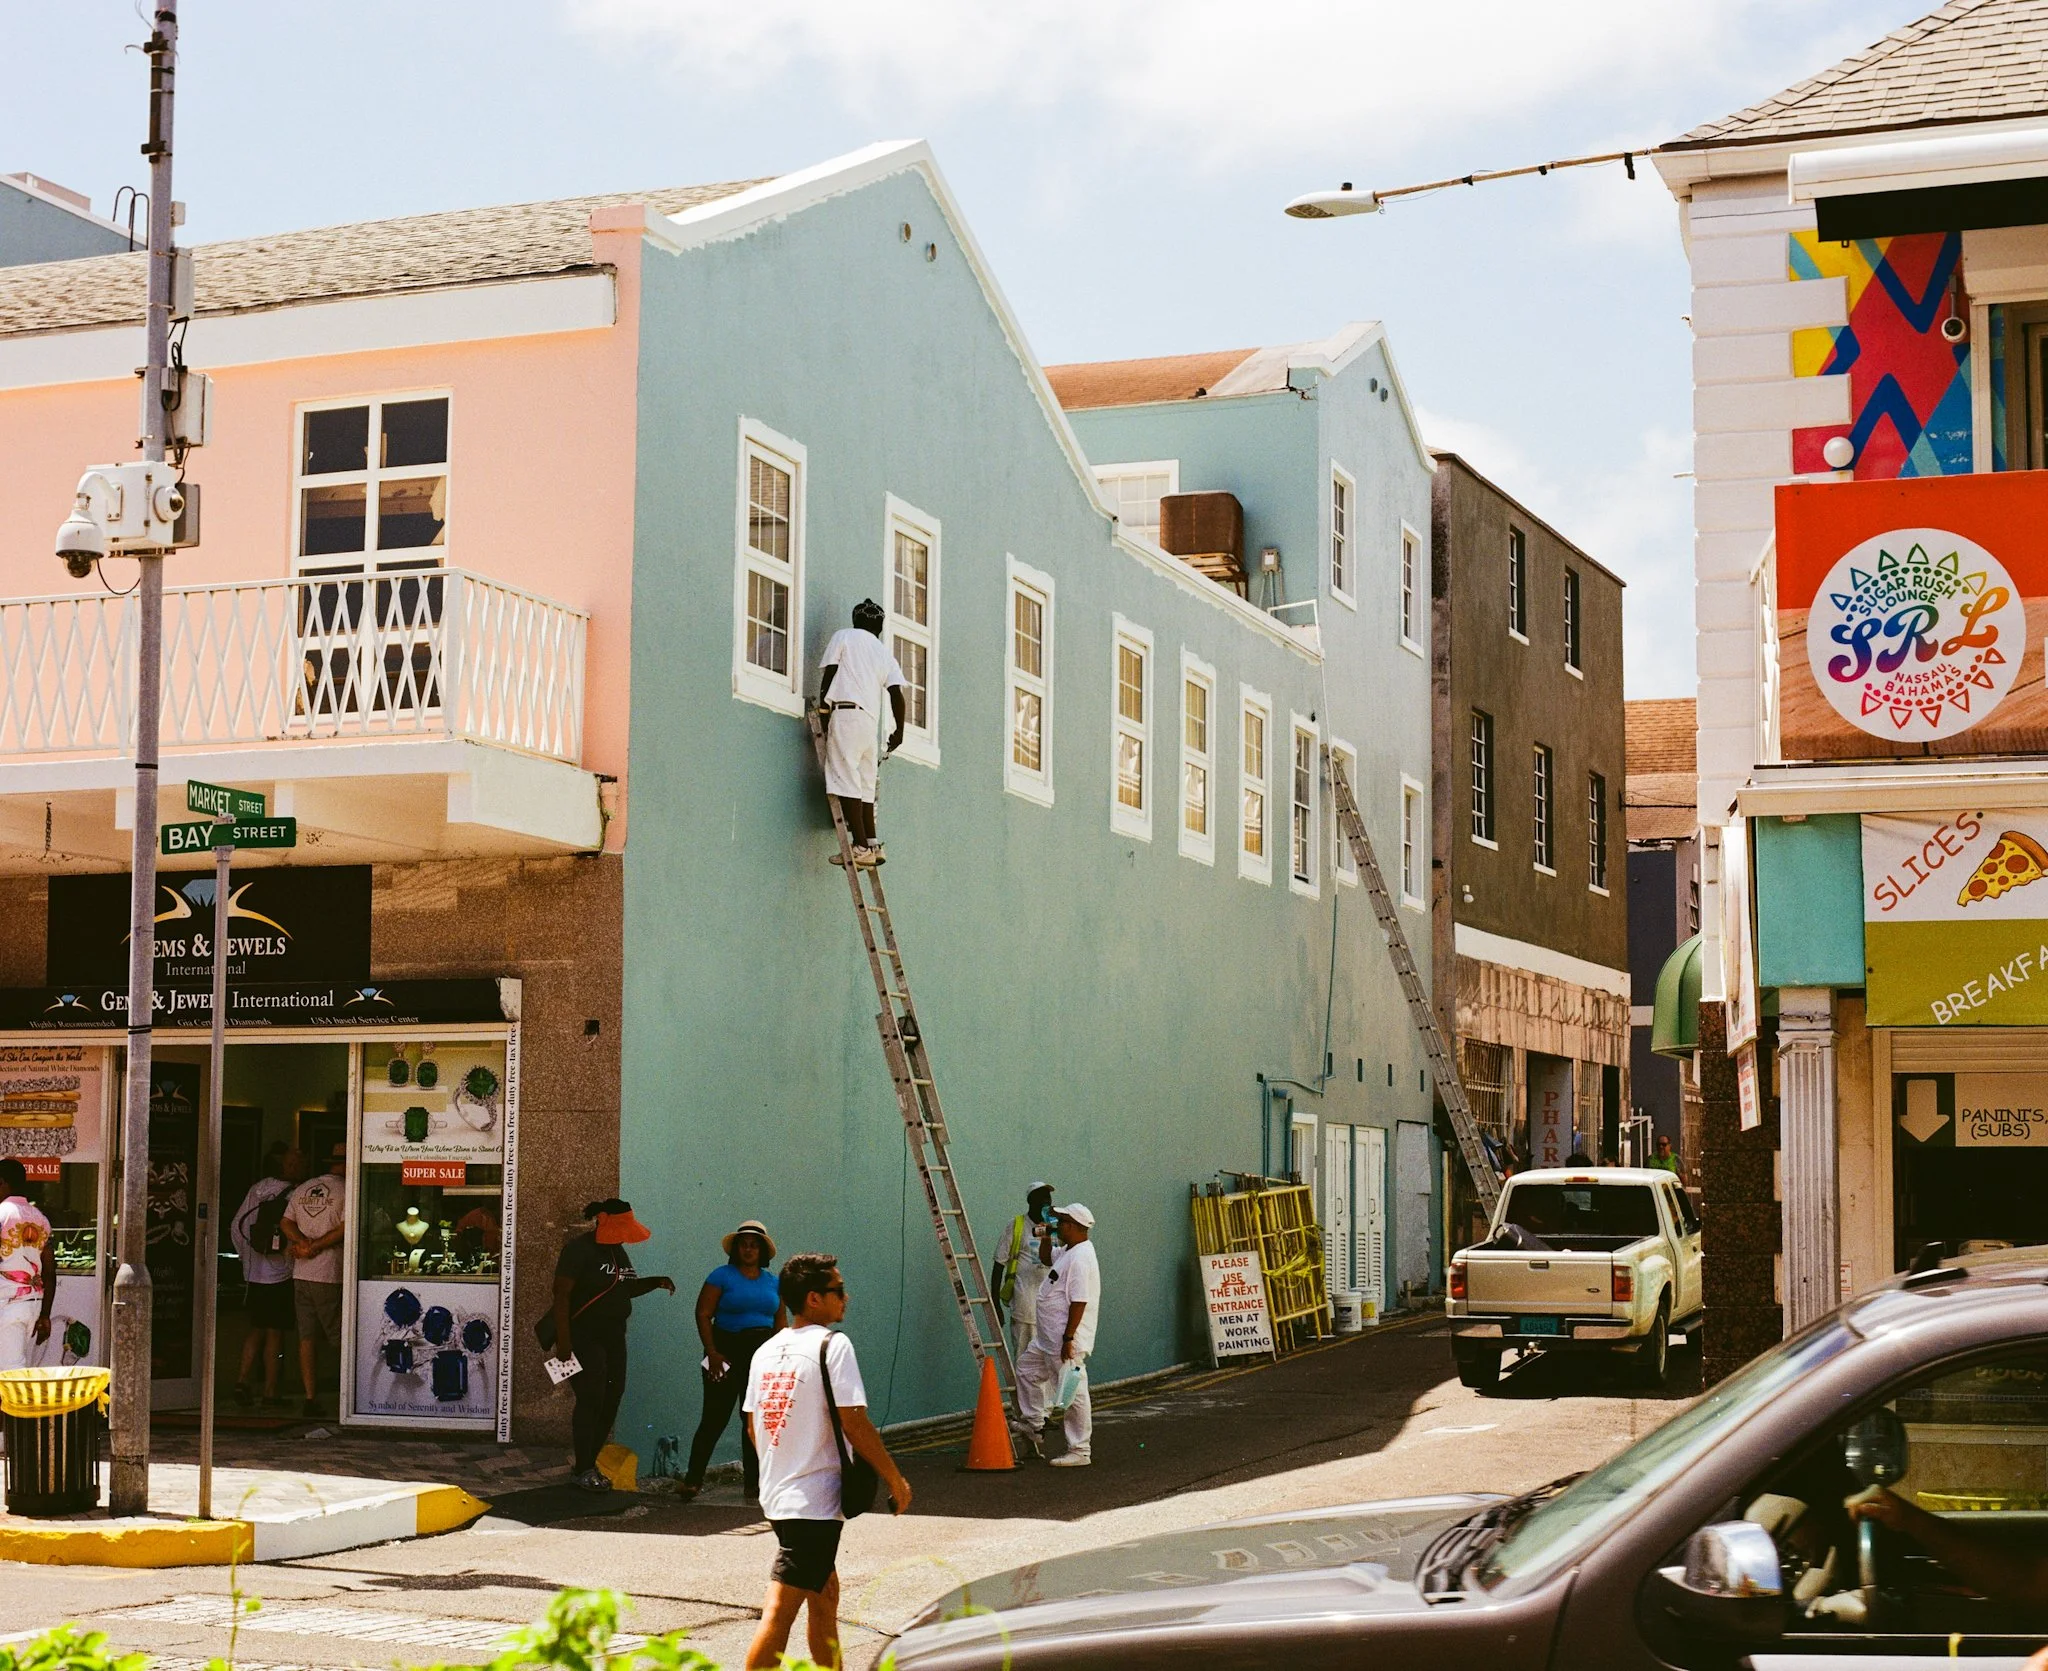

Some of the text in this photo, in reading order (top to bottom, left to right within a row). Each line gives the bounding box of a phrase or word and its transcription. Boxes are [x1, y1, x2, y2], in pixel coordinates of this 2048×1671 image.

[1859, 575, 1956, 616] SUGAR RUSH
[1877, 588, 1938, 614] LOUNGE
[1828, 586, 2010, 683] SRL
[189, 784, 263, 815] MARKET STREET
[168, 824, 287, 850] BAY STREET
[1873, 811, 1983, 912] SLICES
[153, 933, 286, 958] EMS & EWELS
[166, 961, 246, 976] Internatnal
[151, 990, 166, 1010] &
[232, 990, 334, 1009] International
[310, 1016, 332, 1025] USA
[358, 1014, 390, 1024] Service
[390, 1013, 420, 1023] Center
[1541, 1091, 1561, 1168] PHAR
[1971, 1122, 2031, 1140] (SUBS)
[36, 1163, 60, 1175] SALE
[403, 1167, 465, 1179] SUPER SALE
[1211, 1256, 1250, 1270] PLEASE
[1222, 1272, 1243, 1284] USE
[1210, 1285, 1259, 1299] THE NEXT
[1210, 1298, 1265, 1313] ENTRANCE
[1219, 1312, 1260, 1326] MEN AT
[1224, 1325, 1258, 1338] WORK
[1217, 1337, 1271, 1351] PAINTING
[398, 1401, 407, 1412] of
